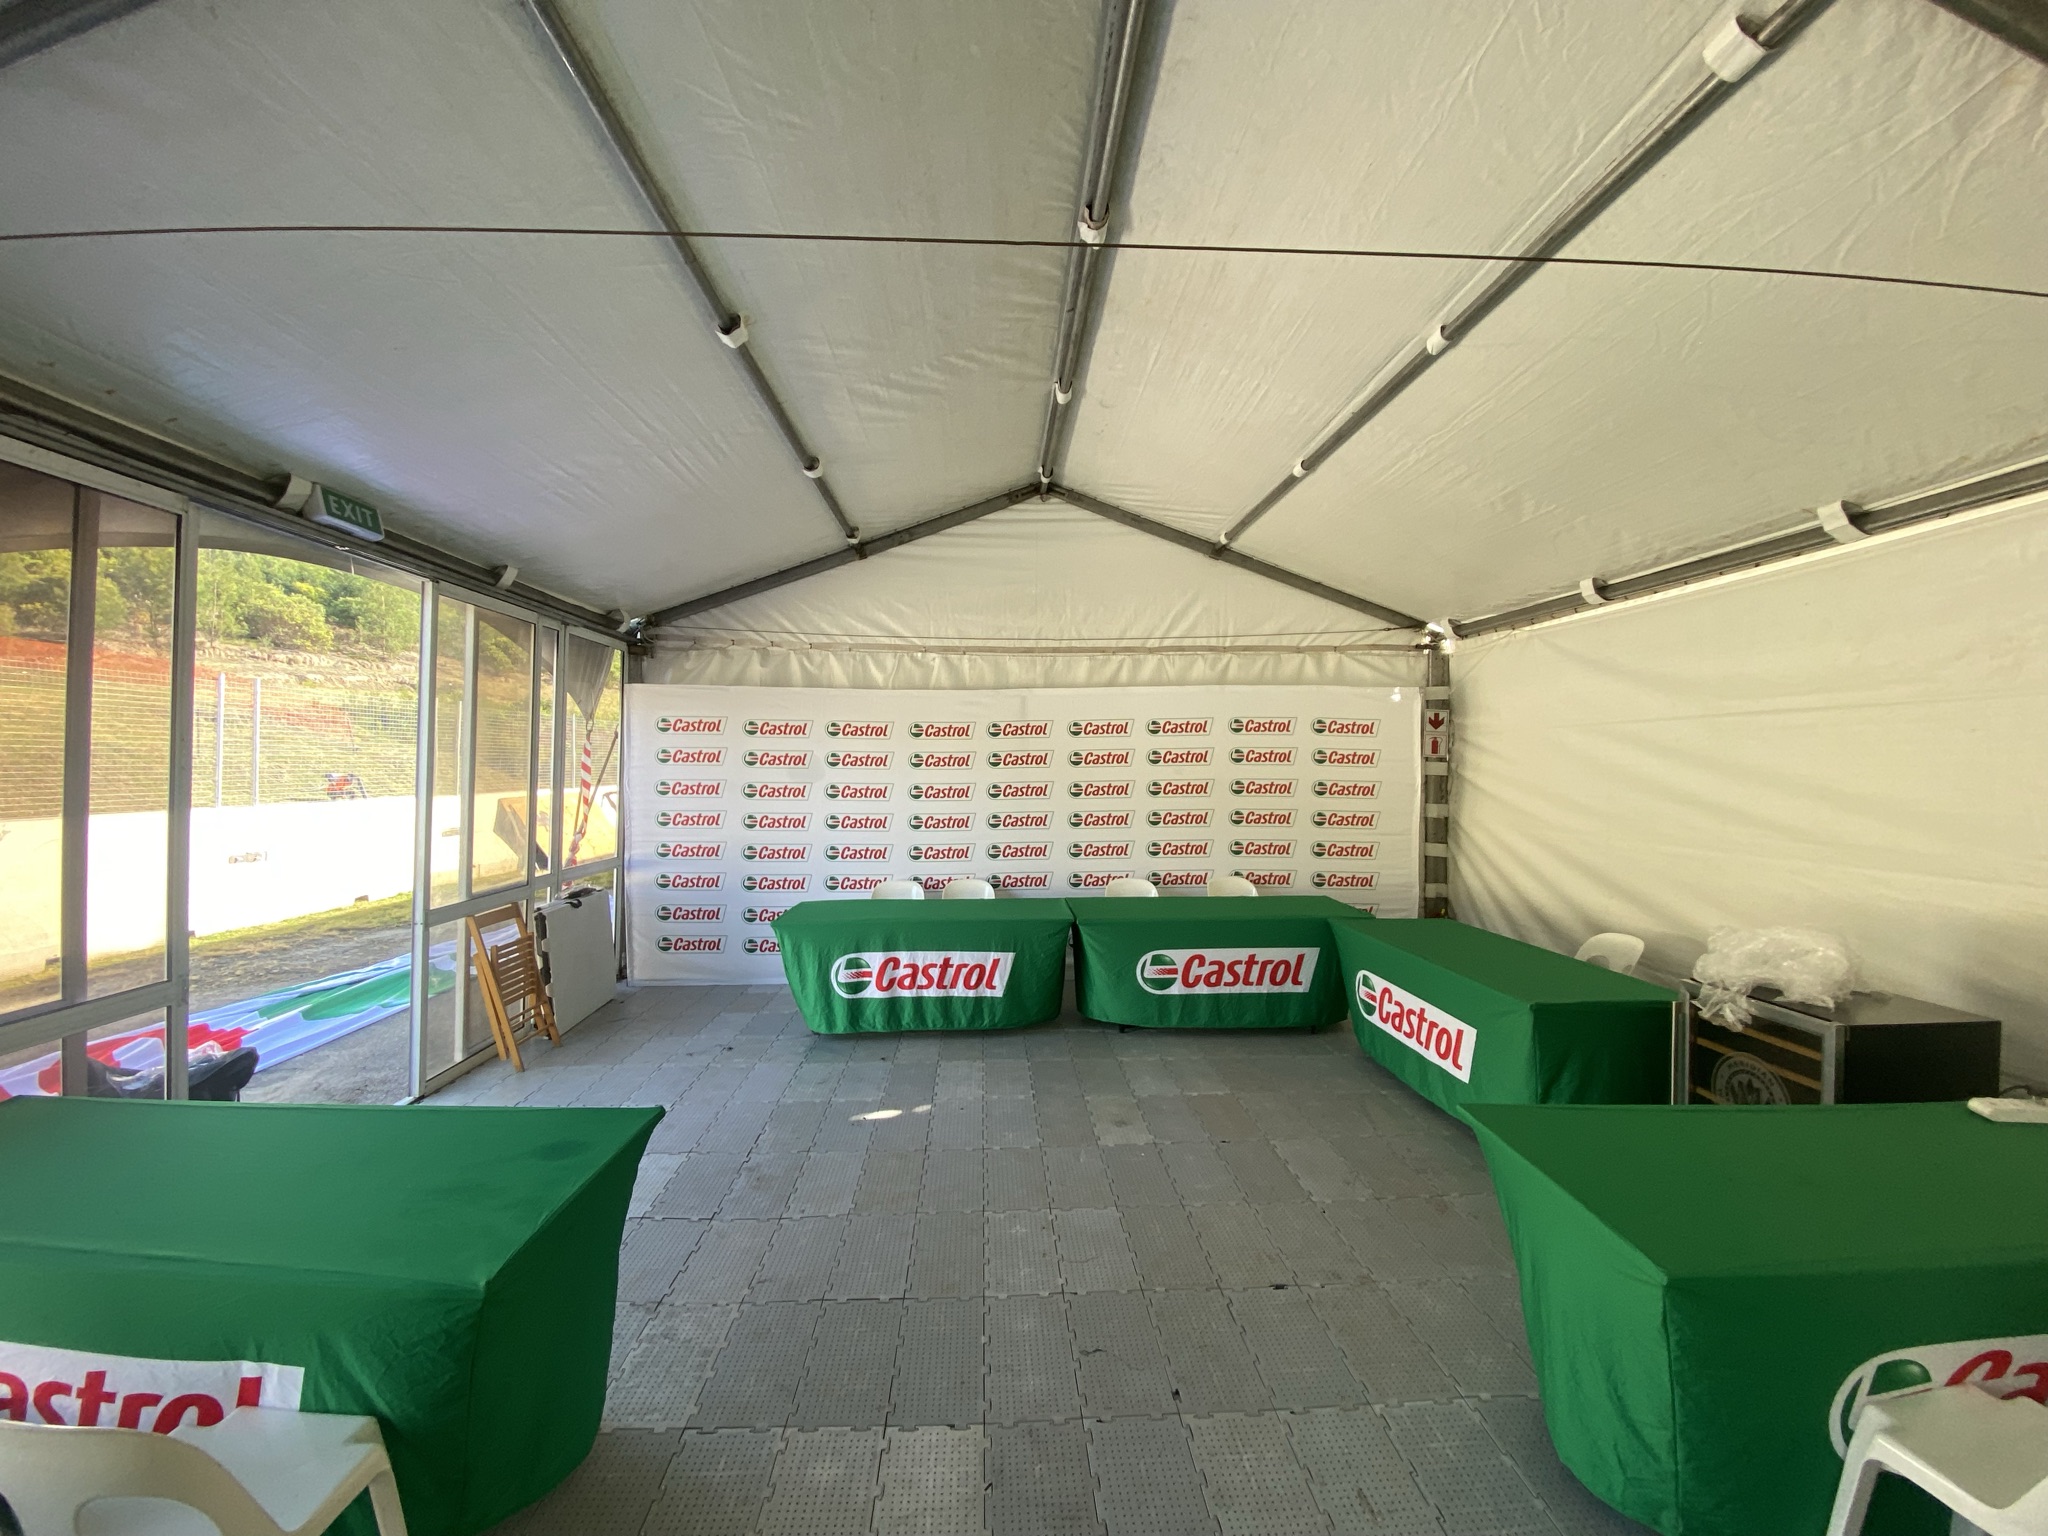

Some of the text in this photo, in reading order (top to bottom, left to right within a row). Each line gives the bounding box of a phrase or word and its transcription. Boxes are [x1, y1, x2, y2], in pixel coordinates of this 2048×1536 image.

[328, 495, 373, 527] EXIT
[671, 717, 721, 733] Castrol
[758, 720, 808, 736] Castrol
[840, 722, 889, 737] Castrol
[923, 723, 971, 738] Castrol
[1000, 722, 1048, 737] Castrol
[1081, 721, 1129, 736] Castrol
[1161, 719, 1208, 735] Castrol
[1244, 719, 1291, 734] Castrol
[1326, 719, 1375, 735] Castrol
[671, 748, 721, 764] Castrol
[758, 751, 808, 767] Castrol
[840, 752, 889, 768] Castrol
[924, 753, 971, 768] Castrol
[1002, 751, 1048, 767] Castrol
[1082, 751, 1130, 767] Castrol
[1161, 749, 1209, 765] Castrol
[1244, 748, 1293, 764] Castrol
[1327, 750, 1376, 766] Castrol
[671, 780, 721, 796] Castrol
[757, 783, 806, 799] Castrol
[840, 784, 888, 799] Castrol
[923, 785, 971, 800] Castrol
[1001, 783, 1049, 798] Castrol
[1083, 783, 1129, 797] Castrol
[1162, 781, 1209, 796] Castrol
[1244, 780, 1293, 796] Castrol
[1327, 780, 1376, 797] Castrol
[671, 812, 721, 826] Castrol
[757, 815, 807, 829] Castrol
[840, 814, 888, 829] Castrol
[923, 815, 970, 829] Castrol
[1002, 814, 1047, 828] Castrol
[1083, 812, 1129, 827] Castrol
[1161, 811, 1209, 826] Castrol
[1243, 810, 1292, 825] Castrol
[1326, 812, 1375, 827] Castrol
[671, 843, 720, 857] Castrol
[758, 845, 806, 859] Castrol
[840, 846, 887, 860] Castrol
[923, 846, 969, 860] Castrol
[1001, 843, 1047, 858] Castrol
[1083, 843, 1129, 857] Castrol
[1161, 841, 1208, 856] Castrol
[1244, 841, 1291, 855] Castrol
[1326, 842, 1374, 857] Castrol
[672, 874, 719, 888] Castrol
[758, 876, 806, 889] Castrol
[1001, 874, 1046, 887] Castrol
[1083, 873, 1129, 887] Cast
[1161, 872, 1208, 885] Castrol
[1327, 873, 1373, 887] Castrol
[672, 906, 721, 920] Castrol
[673, 937, 722, 951] Castrol
[874, 956, 1000, 992] Castrol
[1180, 953, 1304, 988] Castrol
[1378, 986, 1464, 1071] Castrol
